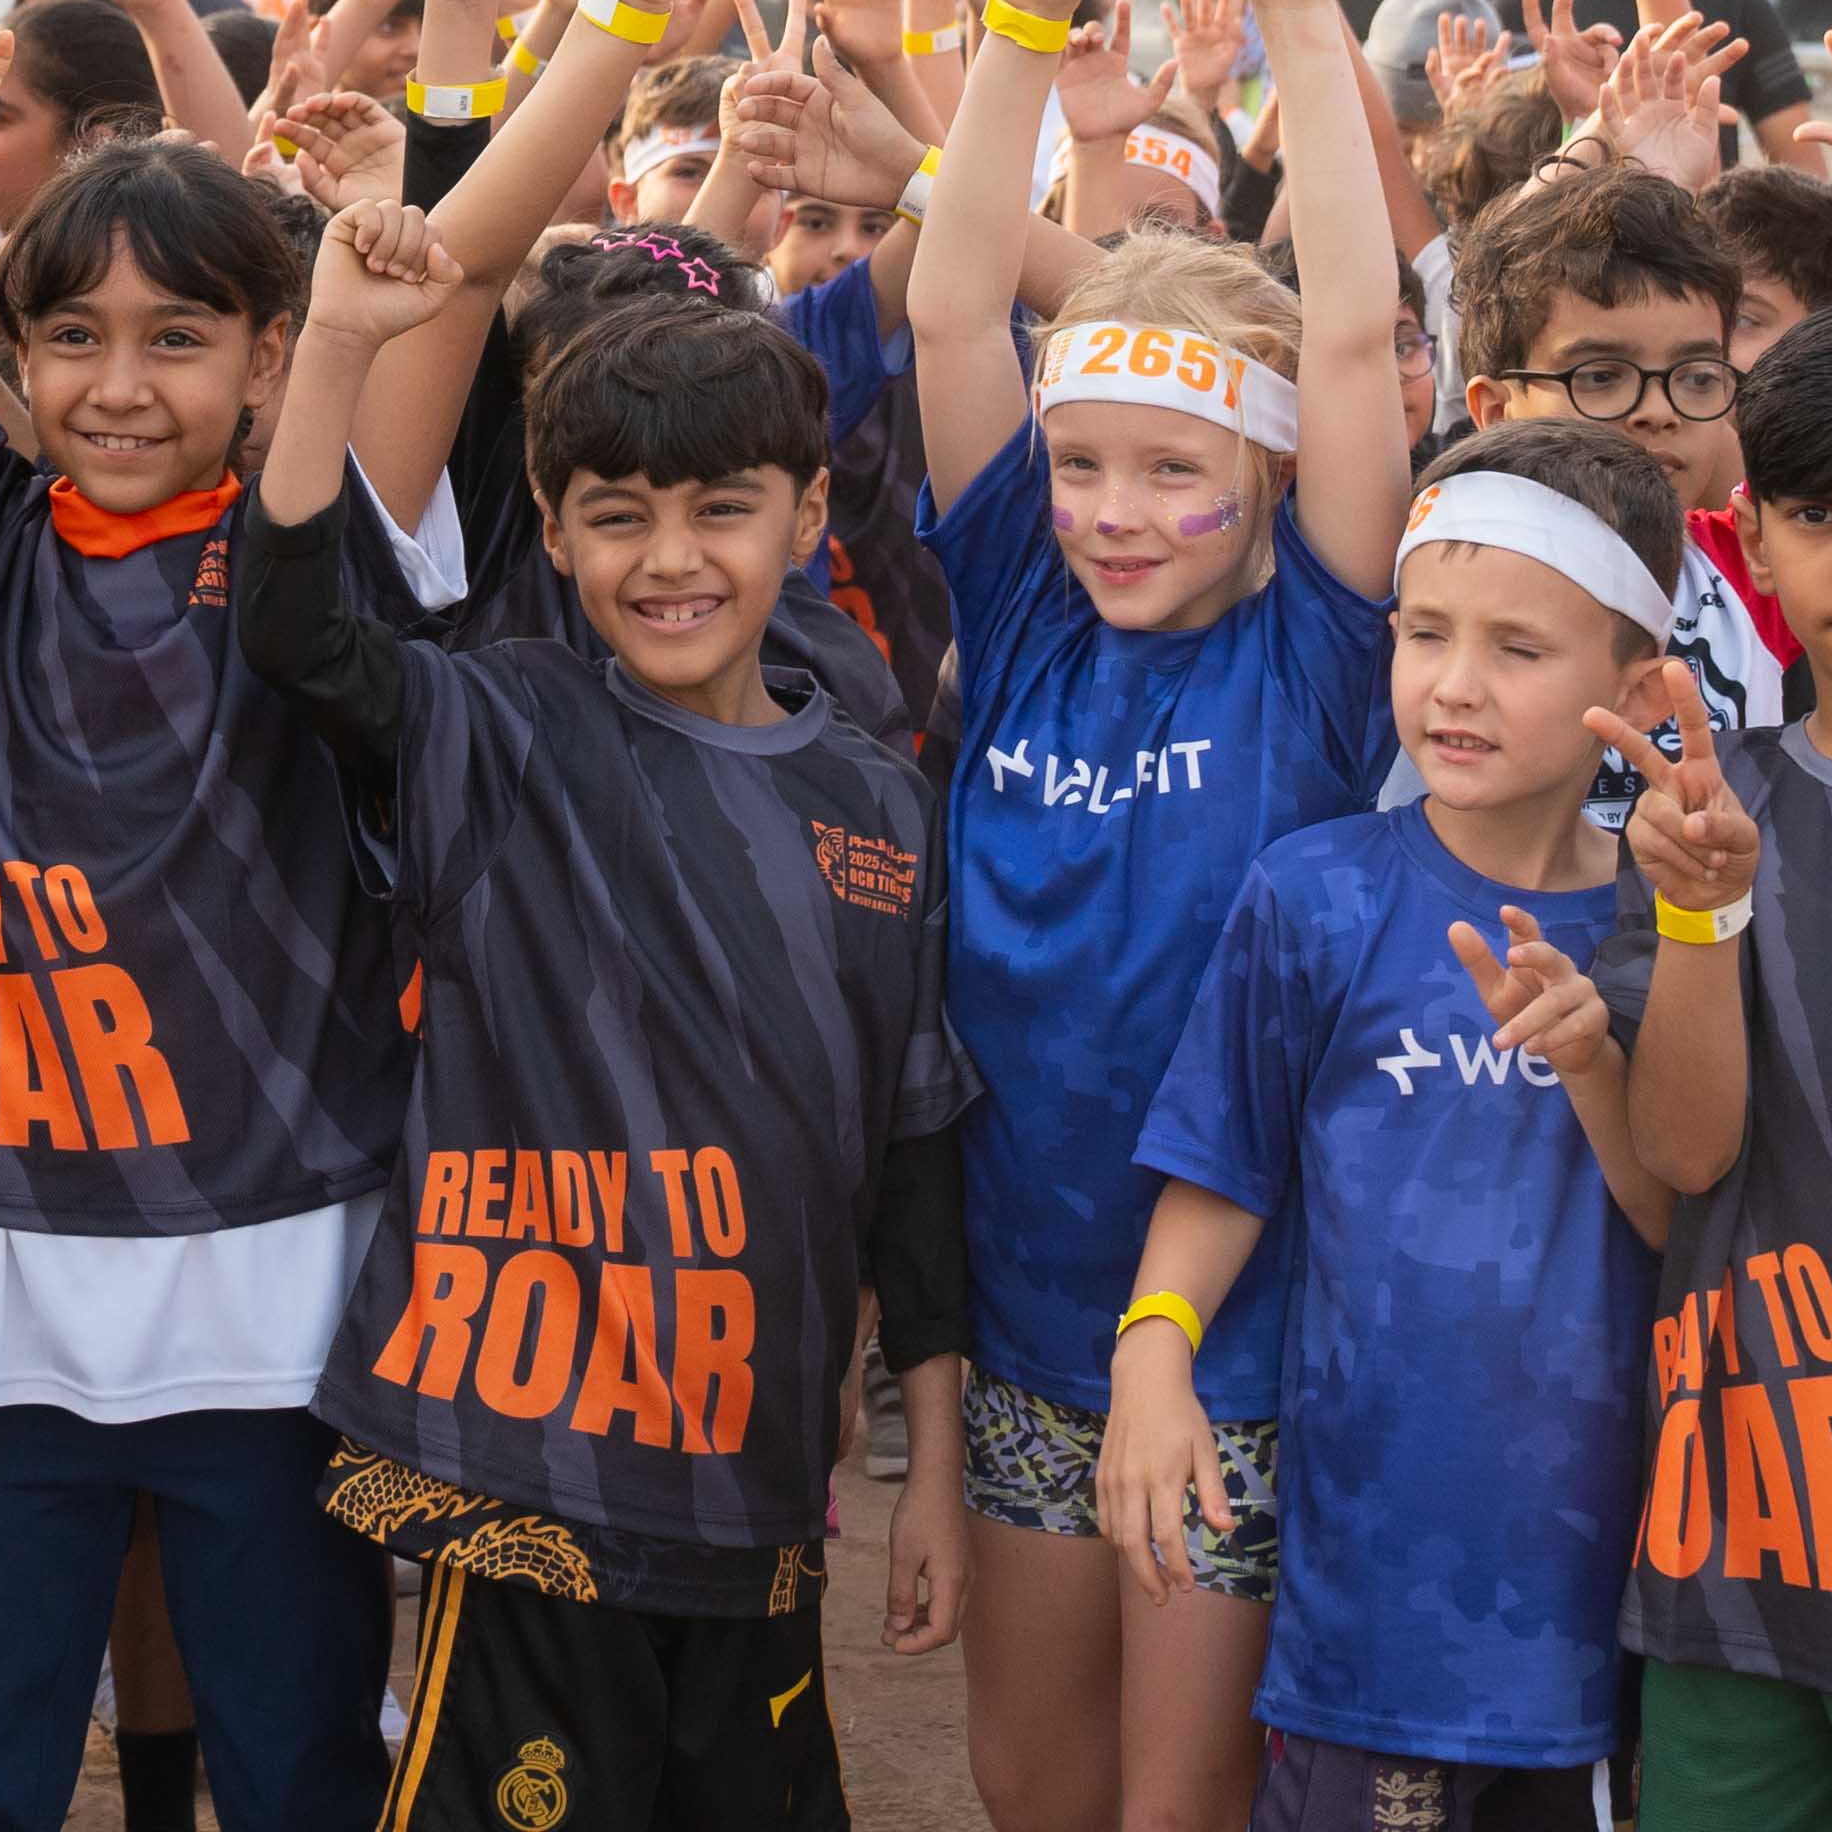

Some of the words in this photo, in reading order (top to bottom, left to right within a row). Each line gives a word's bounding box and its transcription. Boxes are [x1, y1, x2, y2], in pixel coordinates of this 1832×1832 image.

[4, 860, 108, 962] TO
[848, 850, 880, 871] 2025
[849, 868, 876, 888] OCR
[417, 1148, 628, 1252] READY
[649, 1145, 747, 1258] TO
[371, 1242, 757, 1455] ROAR
